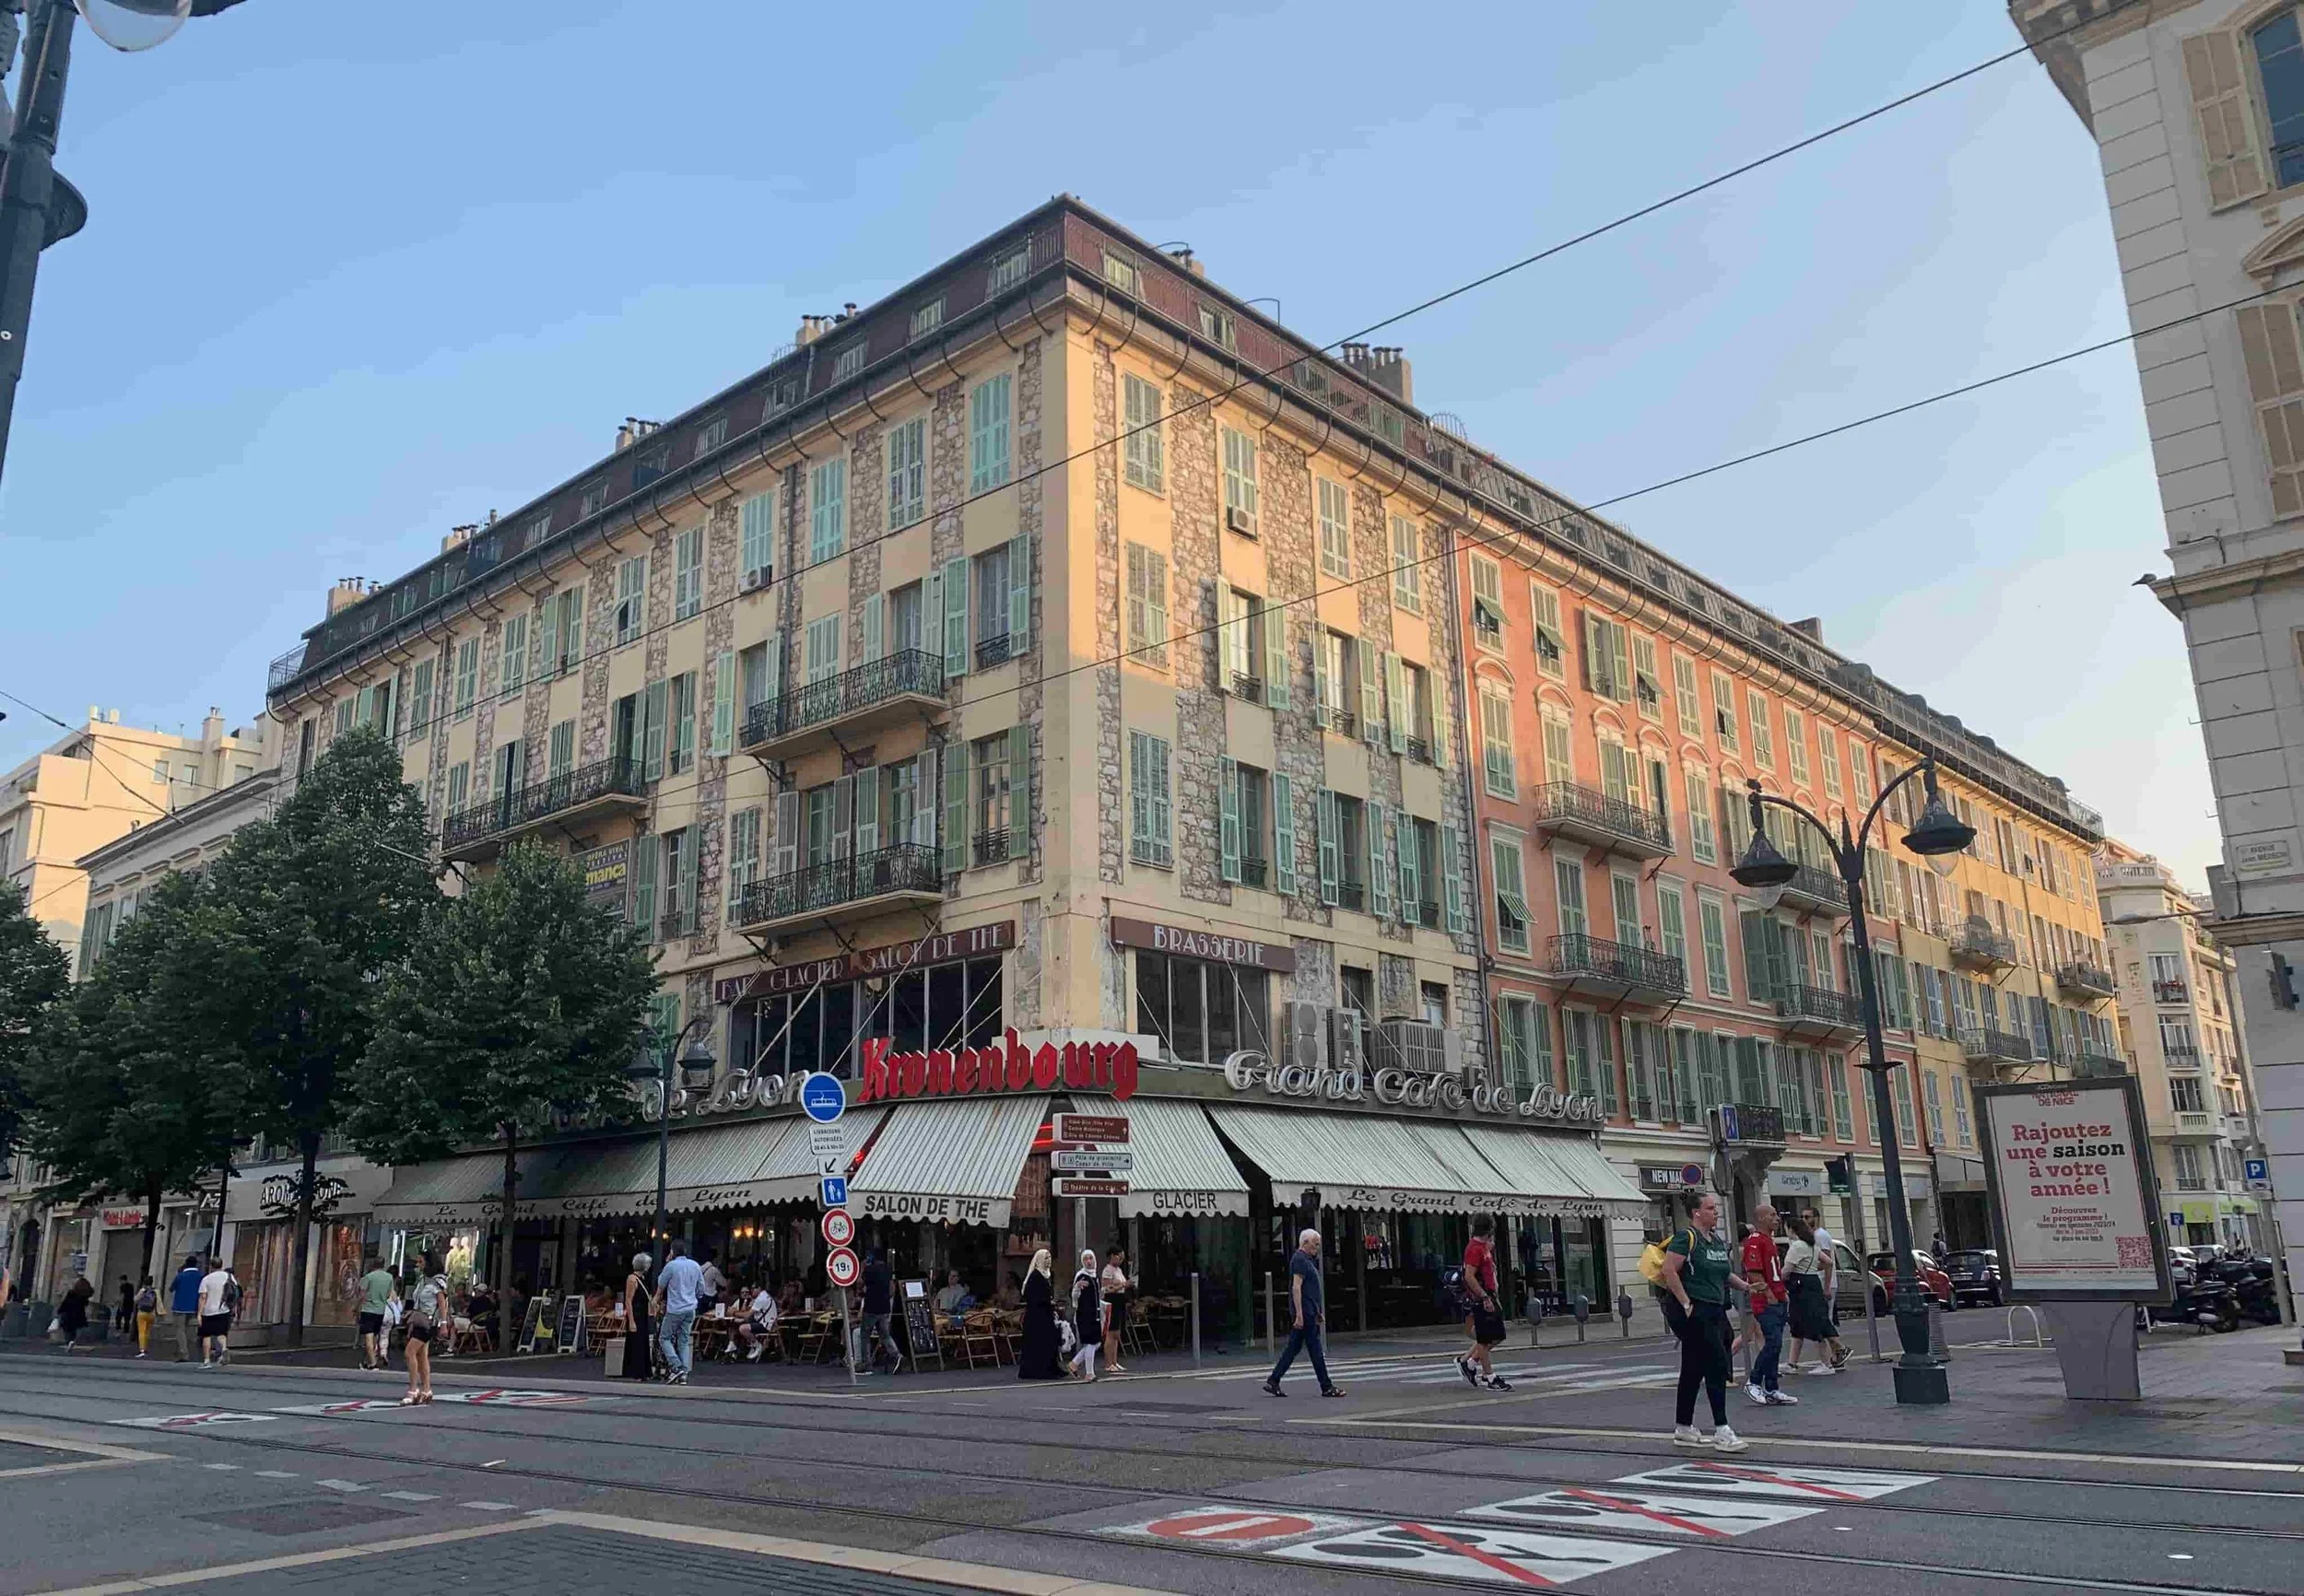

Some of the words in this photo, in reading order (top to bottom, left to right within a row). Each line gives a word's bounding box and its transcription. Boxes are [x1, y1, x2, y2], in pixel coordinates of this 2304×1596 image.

[933, 933, 958, 959] DE
[970, 923, 1004, 951] THE
[1154, 924, 1265, 966] BRASSERIE
[856, 1026, 1139, 1102] Kronenbourg
[696, 1068, 807, 1116] Lyon
[1224, 1050, 1368, 1103] Grand
[1472, 1064, 1513, 1113] de
[1519, 1082, 1605, 1122] Lyon
[2011, 1121, 2112, 1144] Rajoutez
[2006, 1147, 2047, 1160] une
[2052, 1139, 2126, 1158] saison
[1652, 1169, 1668, 1184] NEW
[2028, 1160, 2042, 1179] à
[2045, 1162, 2107, 1178] votre
[2251, 1163, 2261, 1176] P
[2030, 1177, 2099, 1197] année
[436, 1205, 457, 1215] Le
[482, 1203, 535, 1215] Grnd
[561, 1198, 608, 1211] Café
[691, 1190, 753, 1203] Lyon
[864, 1195, 922, 1214] SALON
[927, 1198, 949, 1215] DE
[956, 1199, 990, 1218] THE
[1153, 1191, 1217, 1209] GLACIER
[1348, 1190, 1377, 1202] Le
[1390, 1191, 1456, 1206] Grand
[1469, 1196, 1516, 1209] Café
[1526, 1199, 1548, 1209] de
[1559, 1201, 1605, 1213] Lyon
[835, 1262, 851, 1273] 19t
